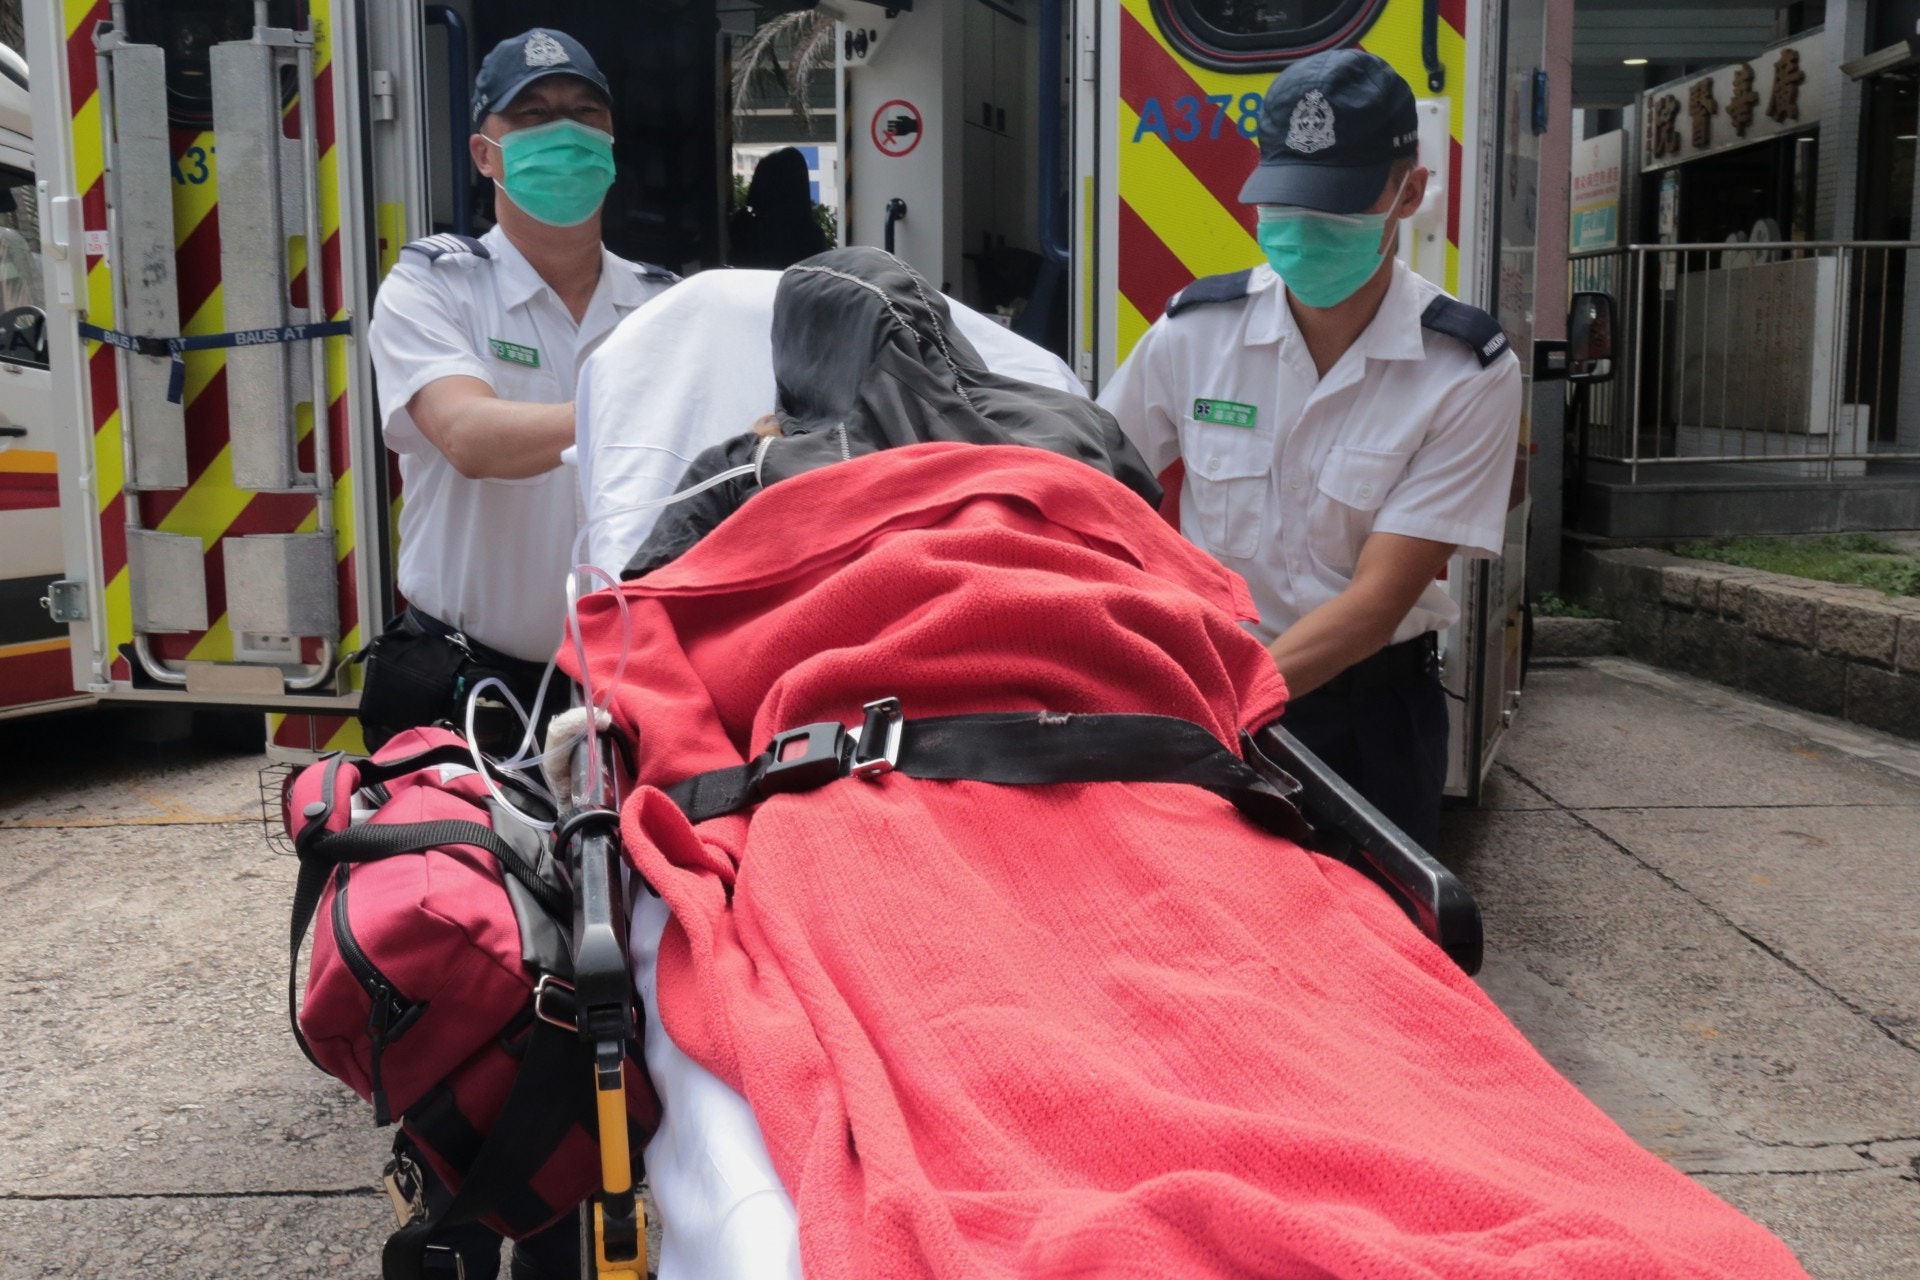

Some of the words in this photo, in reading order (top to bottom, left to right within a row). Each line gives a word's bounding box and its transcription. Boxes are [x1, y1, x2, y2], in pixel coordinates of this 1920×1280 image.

[1132, 92, 1262, 143] A378
[170, 146, 216, 185] A3
[103, 330, 131, 349] BAUS
[234, 329, 279, 345] BAUS
[283, 325, 306, 340] AT
